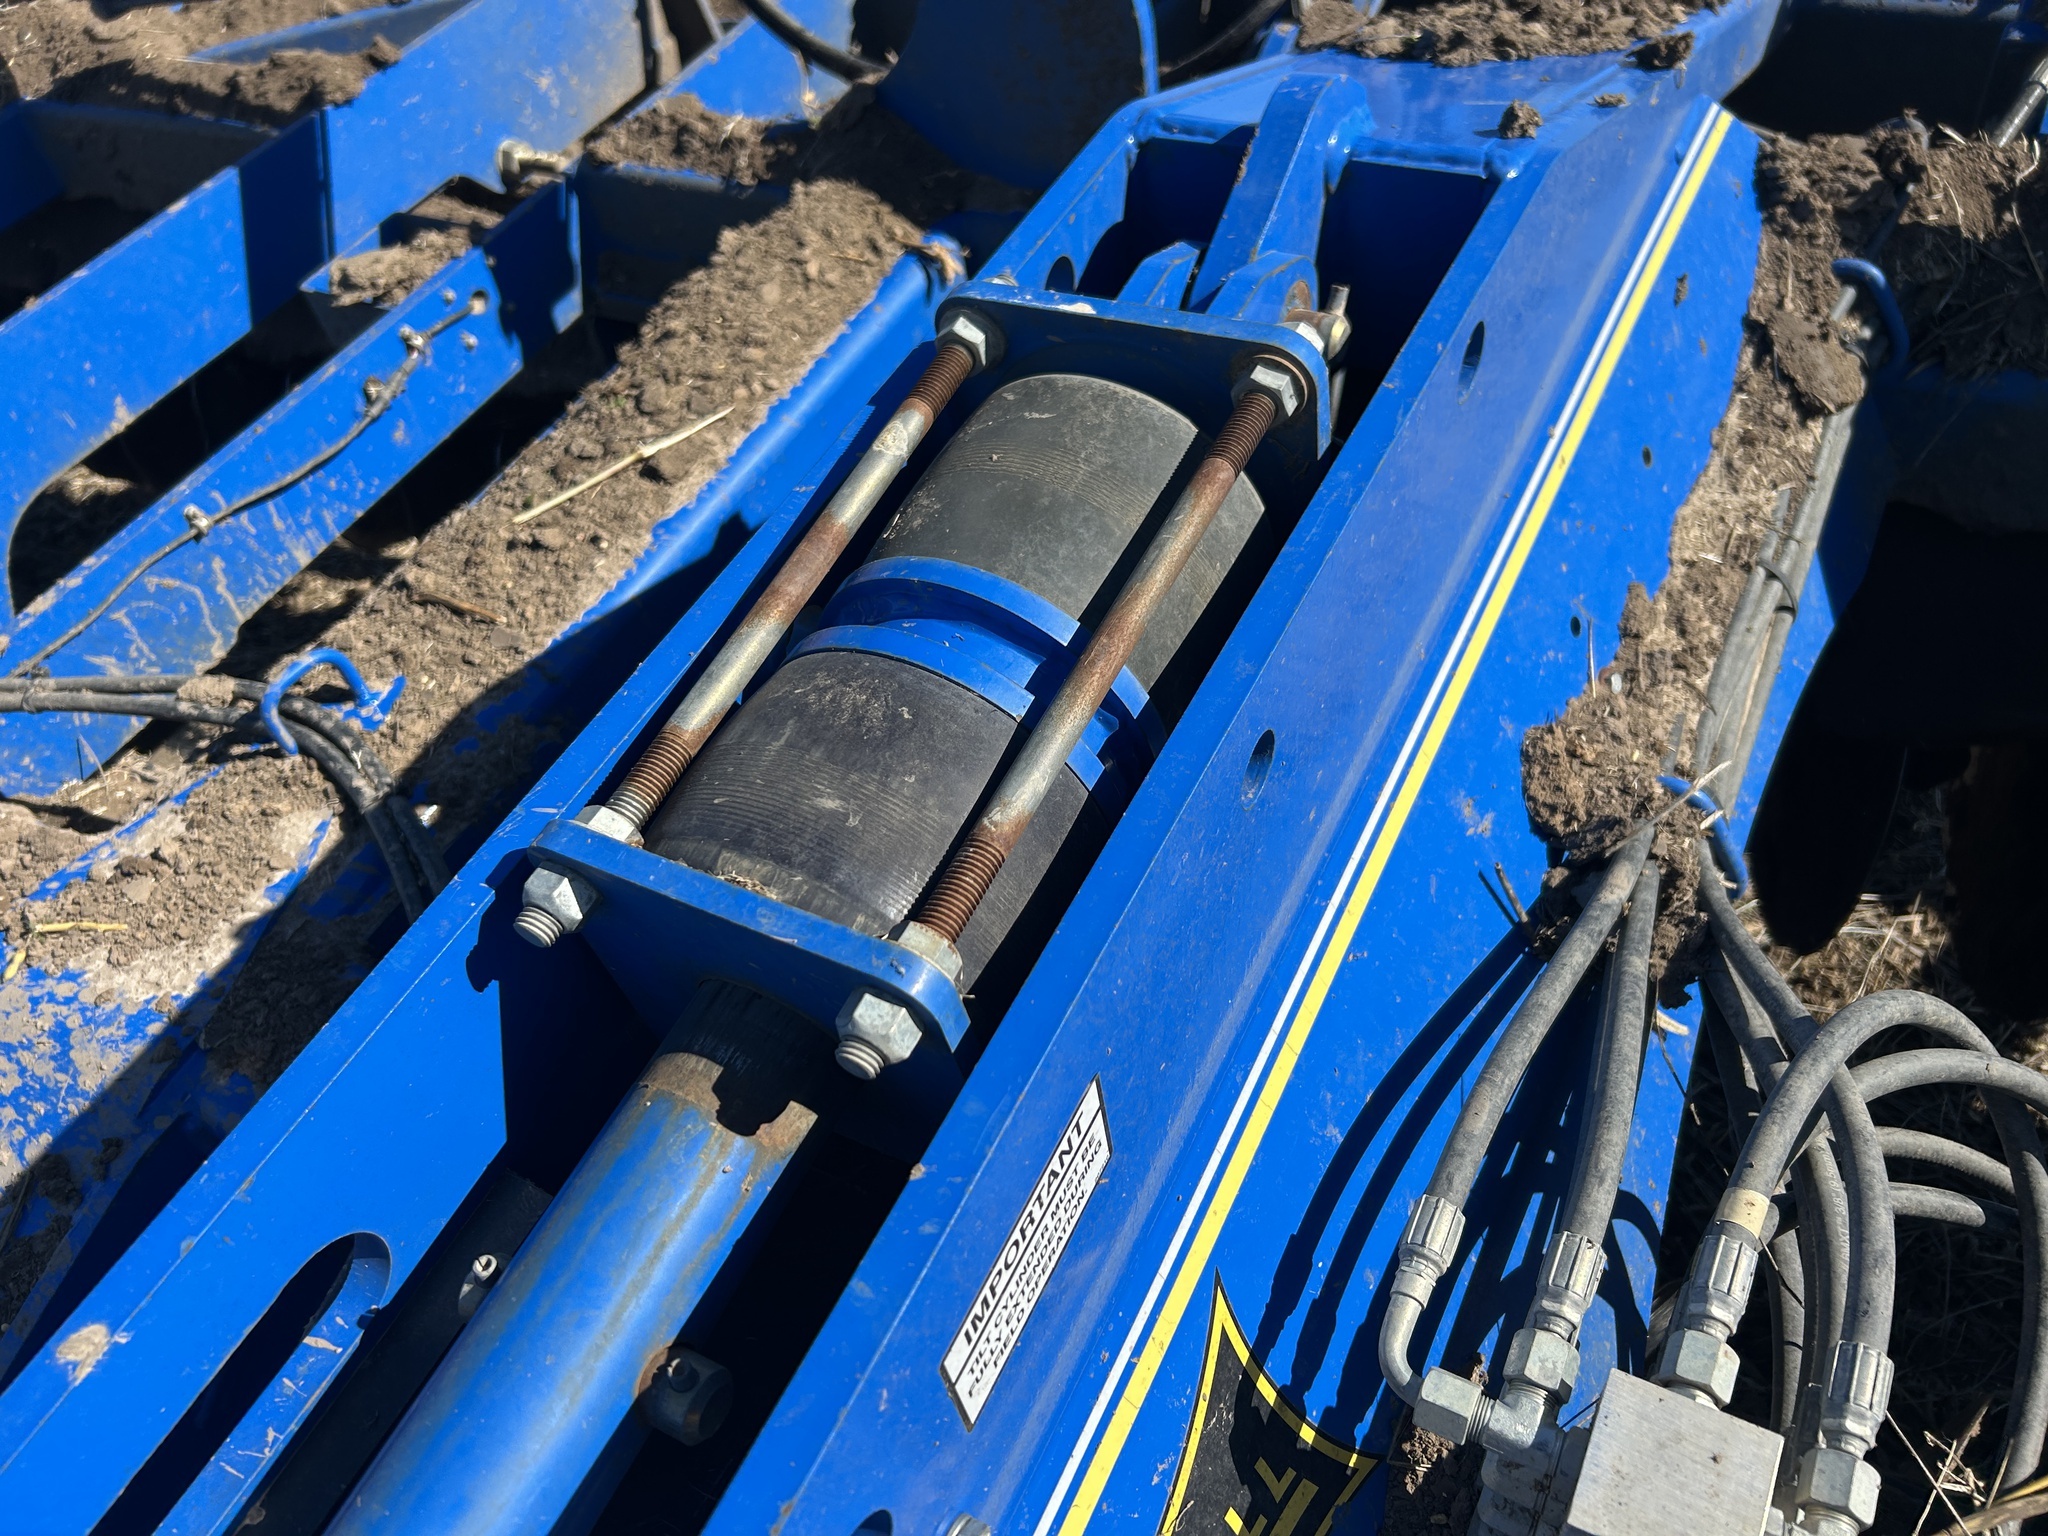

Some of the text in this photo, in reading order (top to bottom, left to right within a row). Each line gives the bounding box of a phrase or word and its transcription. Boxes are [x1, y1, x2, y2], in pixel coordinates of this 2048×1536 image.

[964, 1111, 1084, 1346] IMPORTANT
[967, 1133, 1096, 1375] TILT CYLINDER MUST BE
[968, 1139, 1102, 1397] FULLY EXTENDED DURING
[994, 1189, 1088, 1369] FIELD OPERATION.
